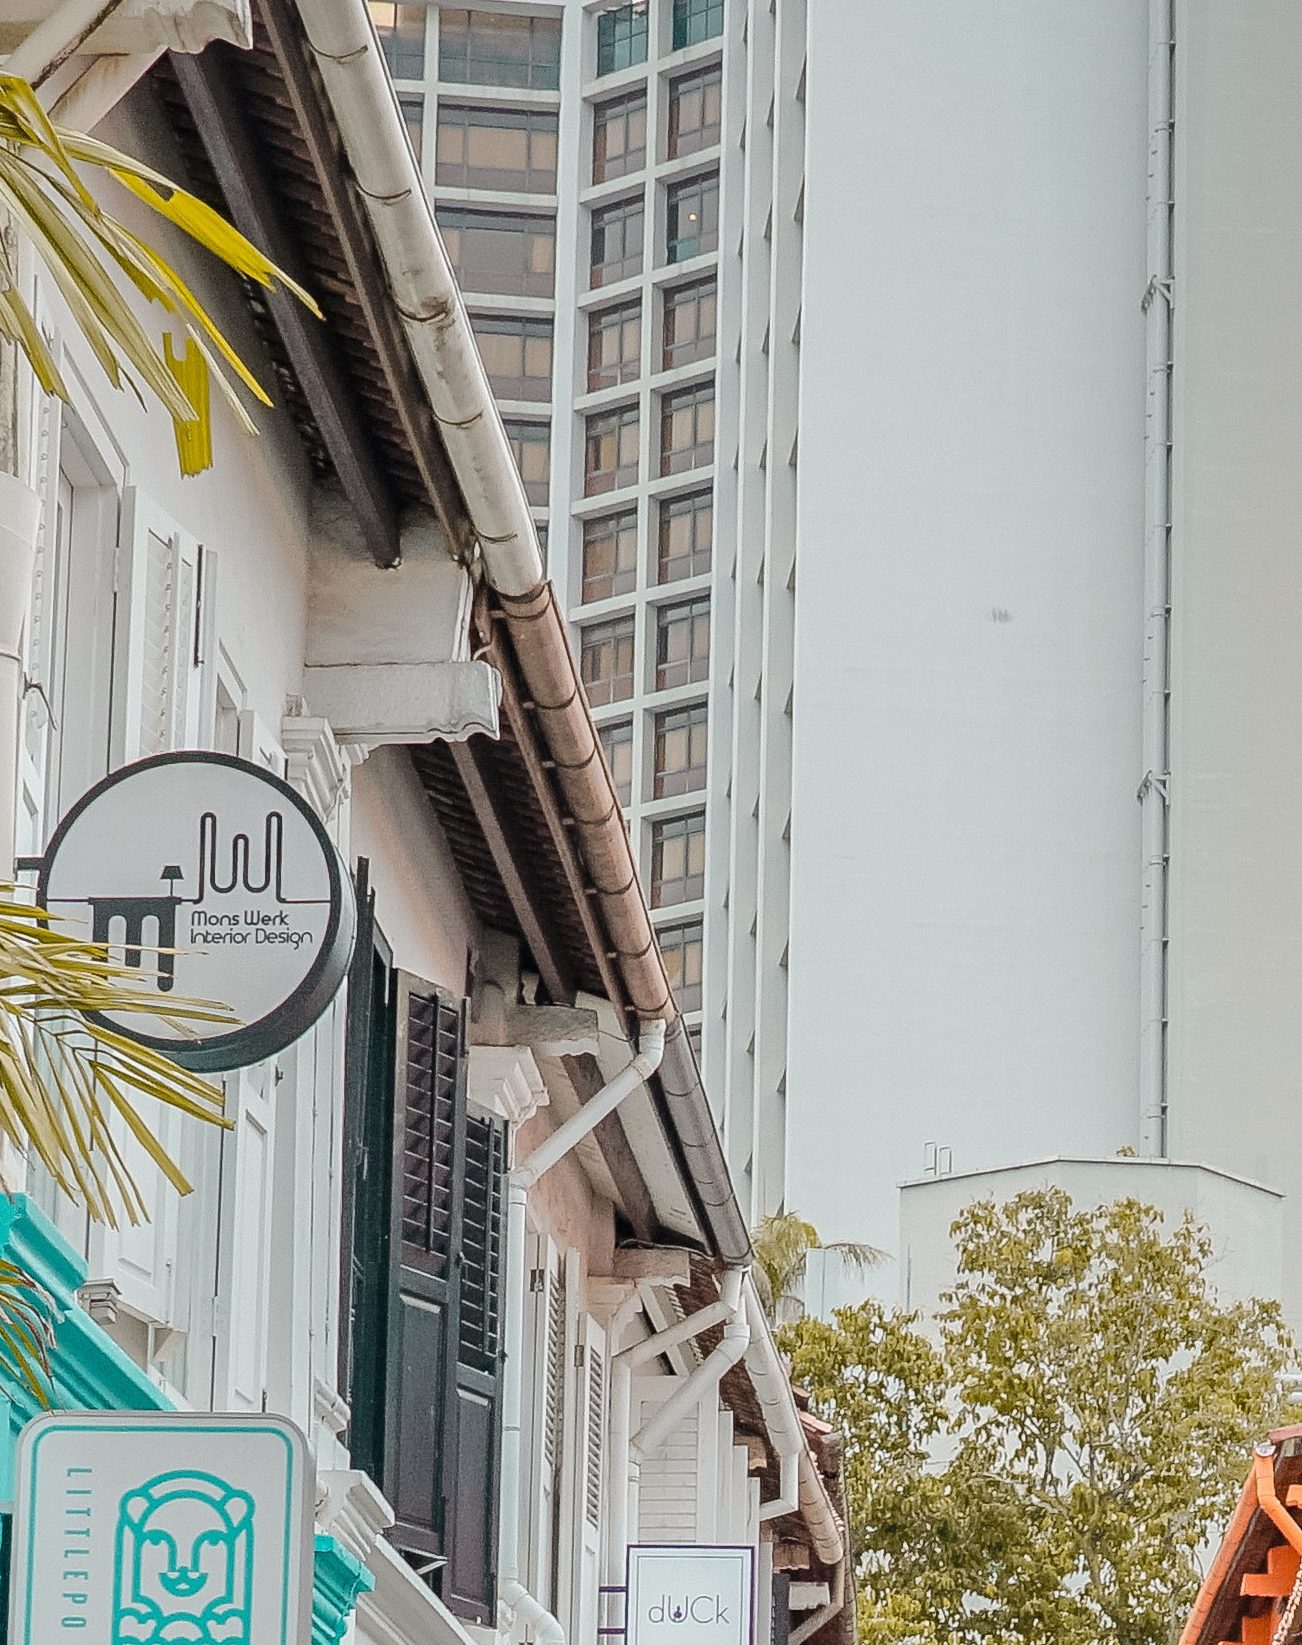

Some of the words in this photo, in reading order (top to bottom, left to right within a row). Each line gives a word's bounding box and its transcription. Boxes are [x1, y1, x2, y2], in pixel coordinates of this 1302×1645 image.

[191, 911, 240, 927] Mons
[244, 911, 289, 927] Werk
[190, 928, 250, 945] Interior
[255, 928, 313, 950] Design
[61, 1467, 93, 1629] LITTLEPO
